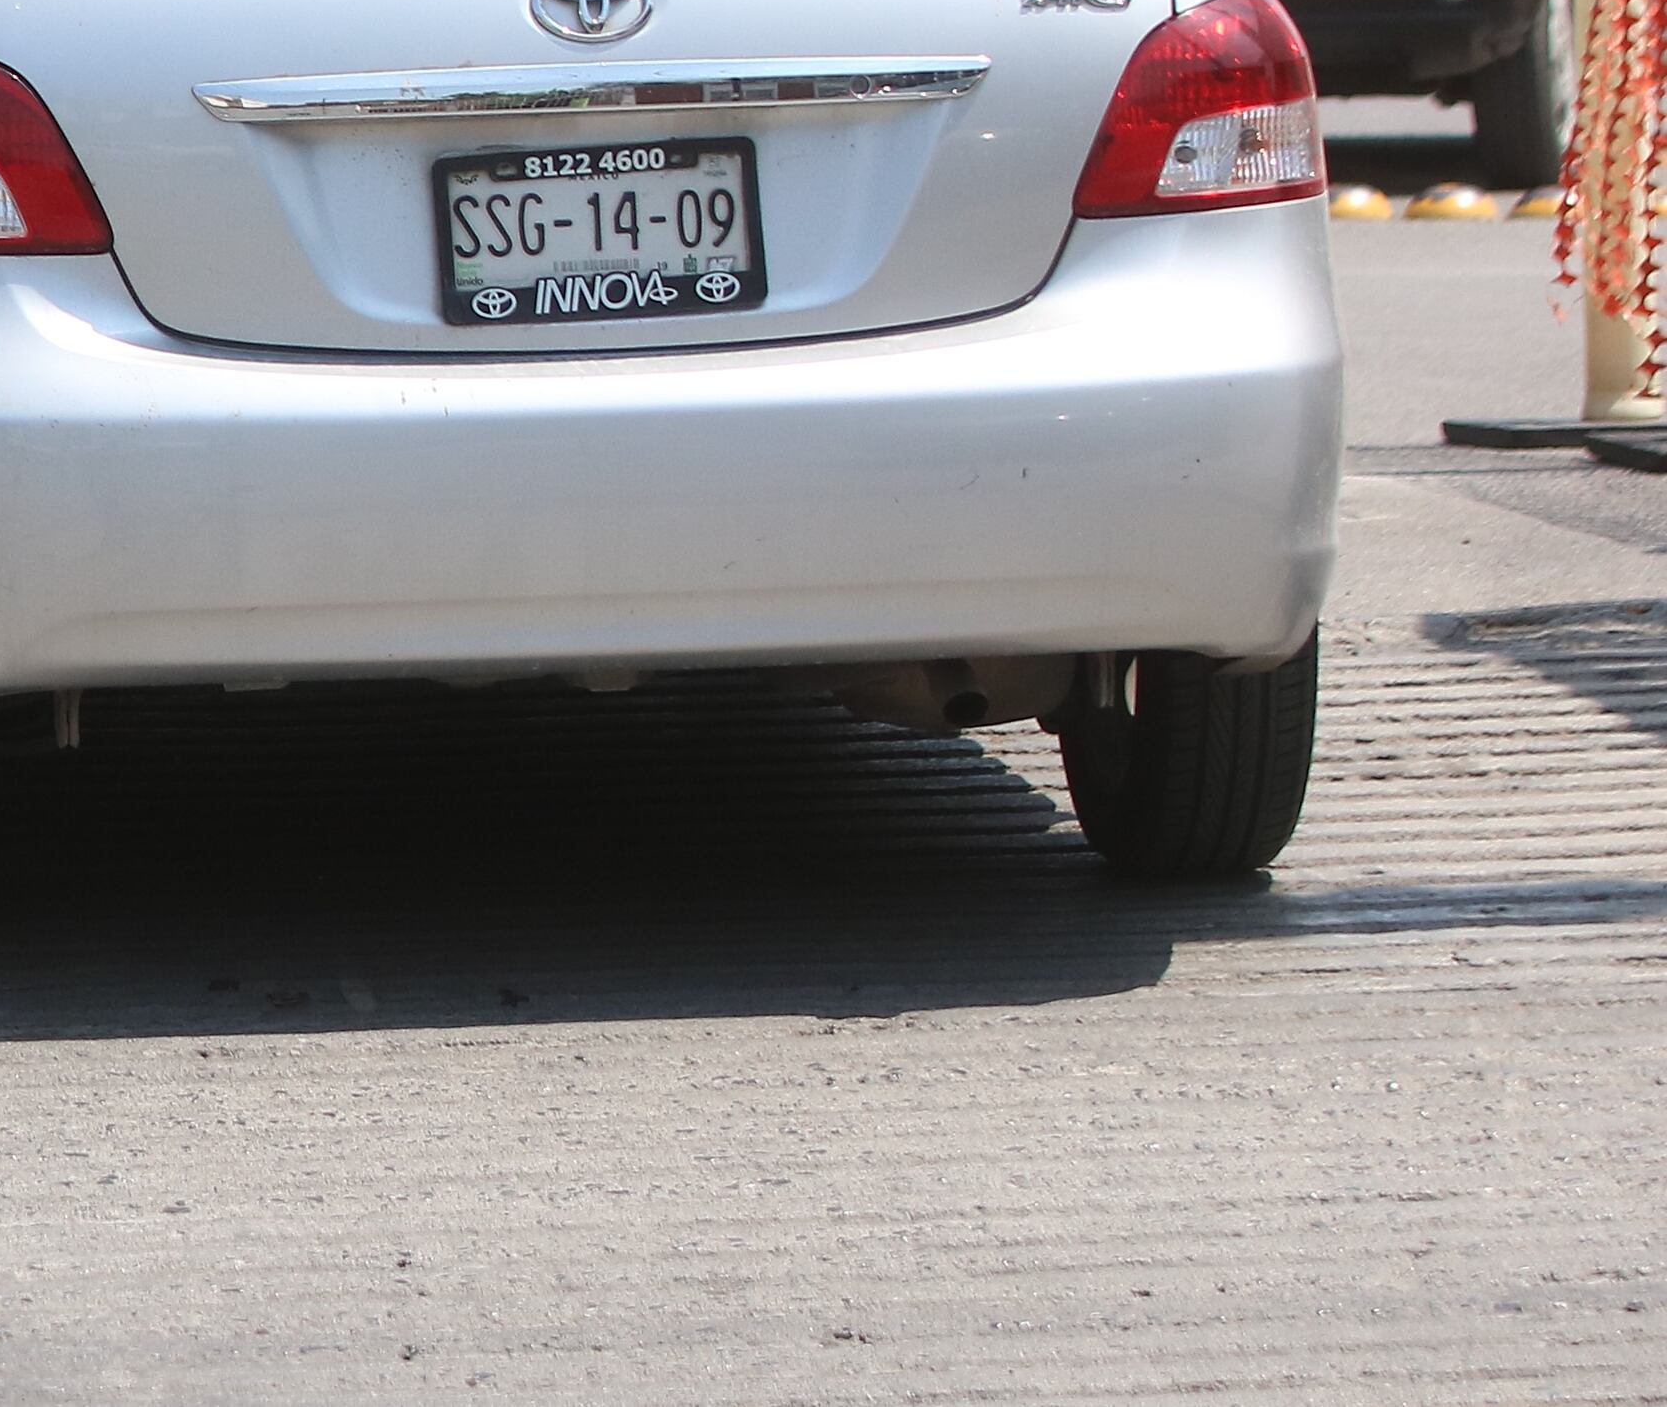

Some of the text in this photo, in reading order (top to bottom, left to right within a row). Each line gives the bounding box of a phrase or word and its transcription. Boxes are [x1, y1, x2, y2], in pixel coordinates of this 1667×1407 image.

[523, 146, 666, 179] 8122 4600
[452, 188, 736, 259] SSG-14-09
[534, 269, 679, 315] INNOVA
